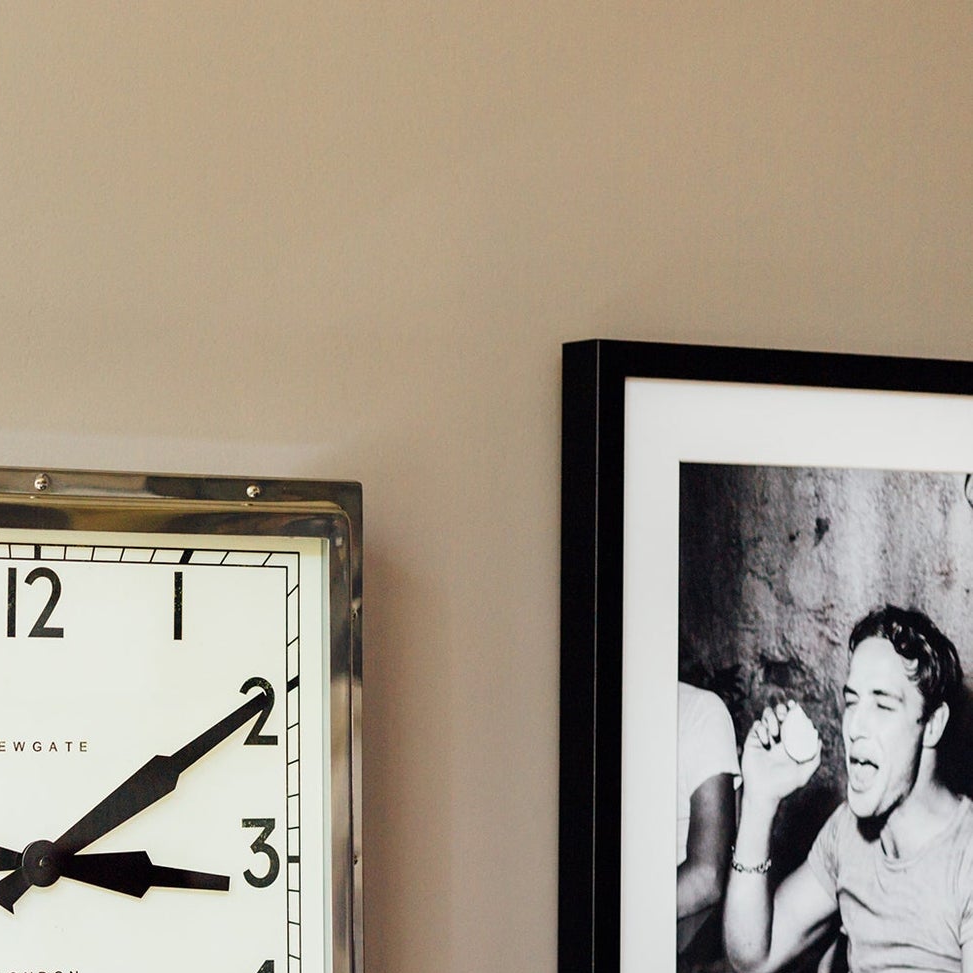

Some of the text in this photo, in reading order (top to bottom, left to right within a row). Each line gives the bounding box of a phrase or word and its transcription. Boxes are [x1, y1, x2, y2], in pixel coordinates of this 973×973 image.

[6, 566, 64, 639] 12
[173, 571, 183, 641] 1
[239, 676, 279, 746] 2
[241, 817, 280, 889] 3
